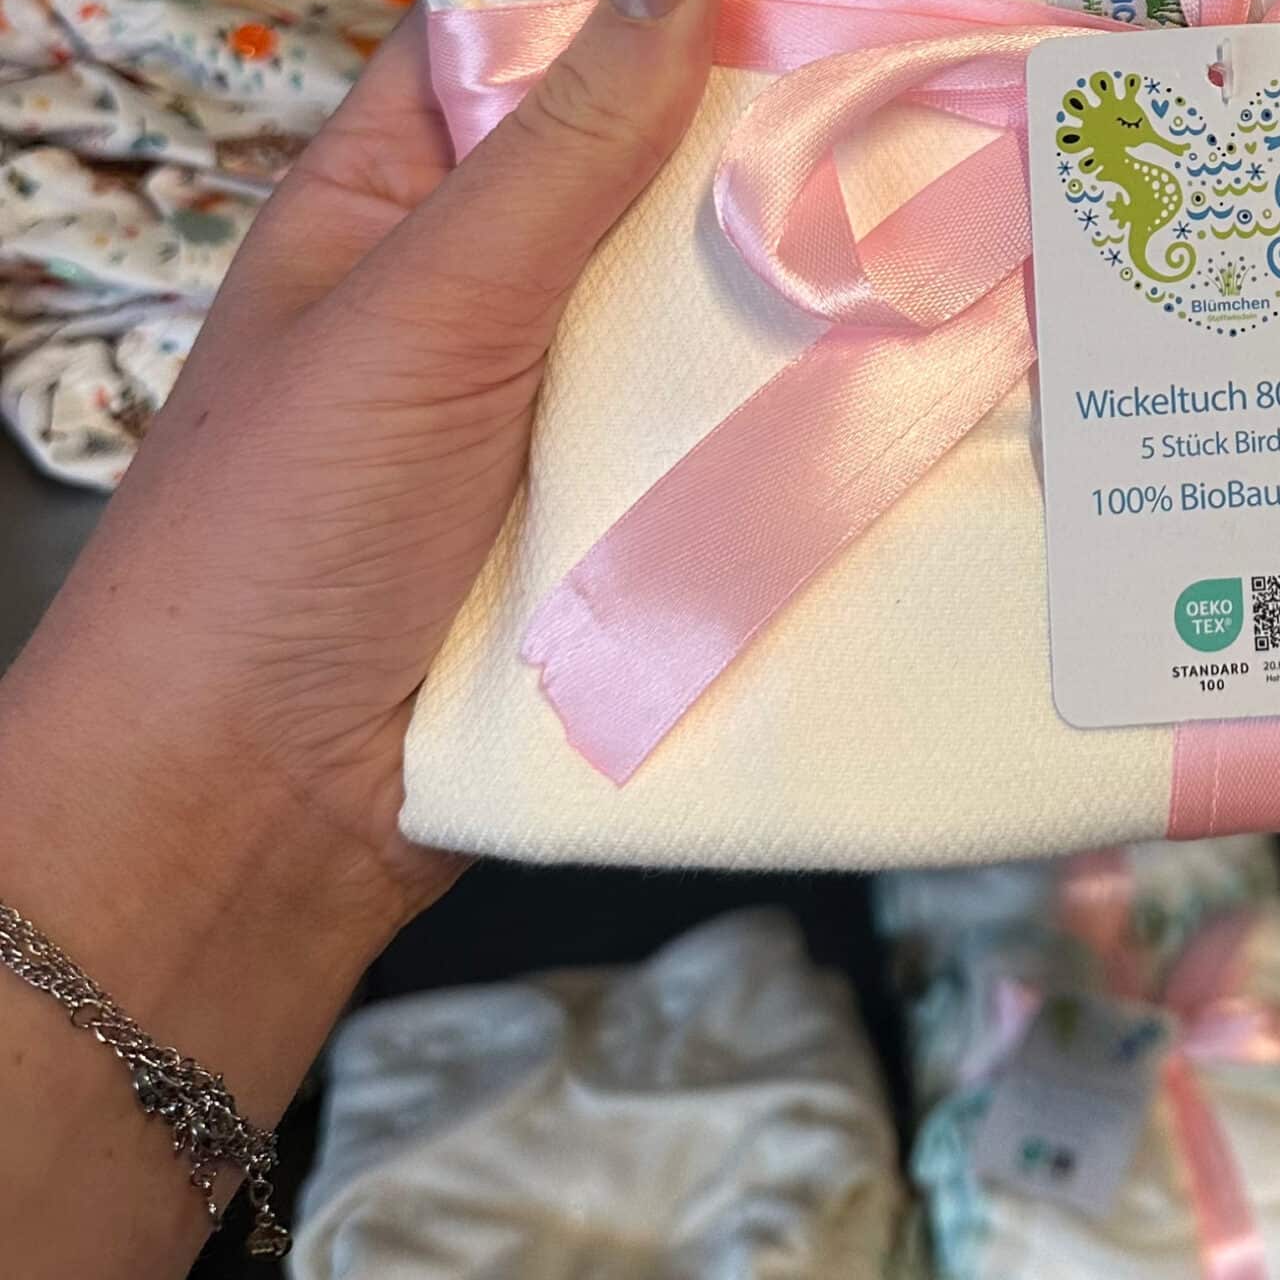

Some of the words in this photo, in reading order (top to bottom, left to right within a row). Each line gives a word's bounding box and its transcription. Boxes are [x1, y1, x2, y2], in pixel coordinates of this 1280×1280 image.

[1191, 297, 1270, 313] Blümchen
[1076, 380, 1247, 419] Wickeltuch
[1141, 437, 1155, 459] 5
[1162, 431, 1229, 458] Stück
[1092, 484, 1173, 516] 100%
[1186, 599, 1233, 617] OEKO
[1172, 663, 1249, 678] STANDARD
[1200, 679, 1225, 691] 100
